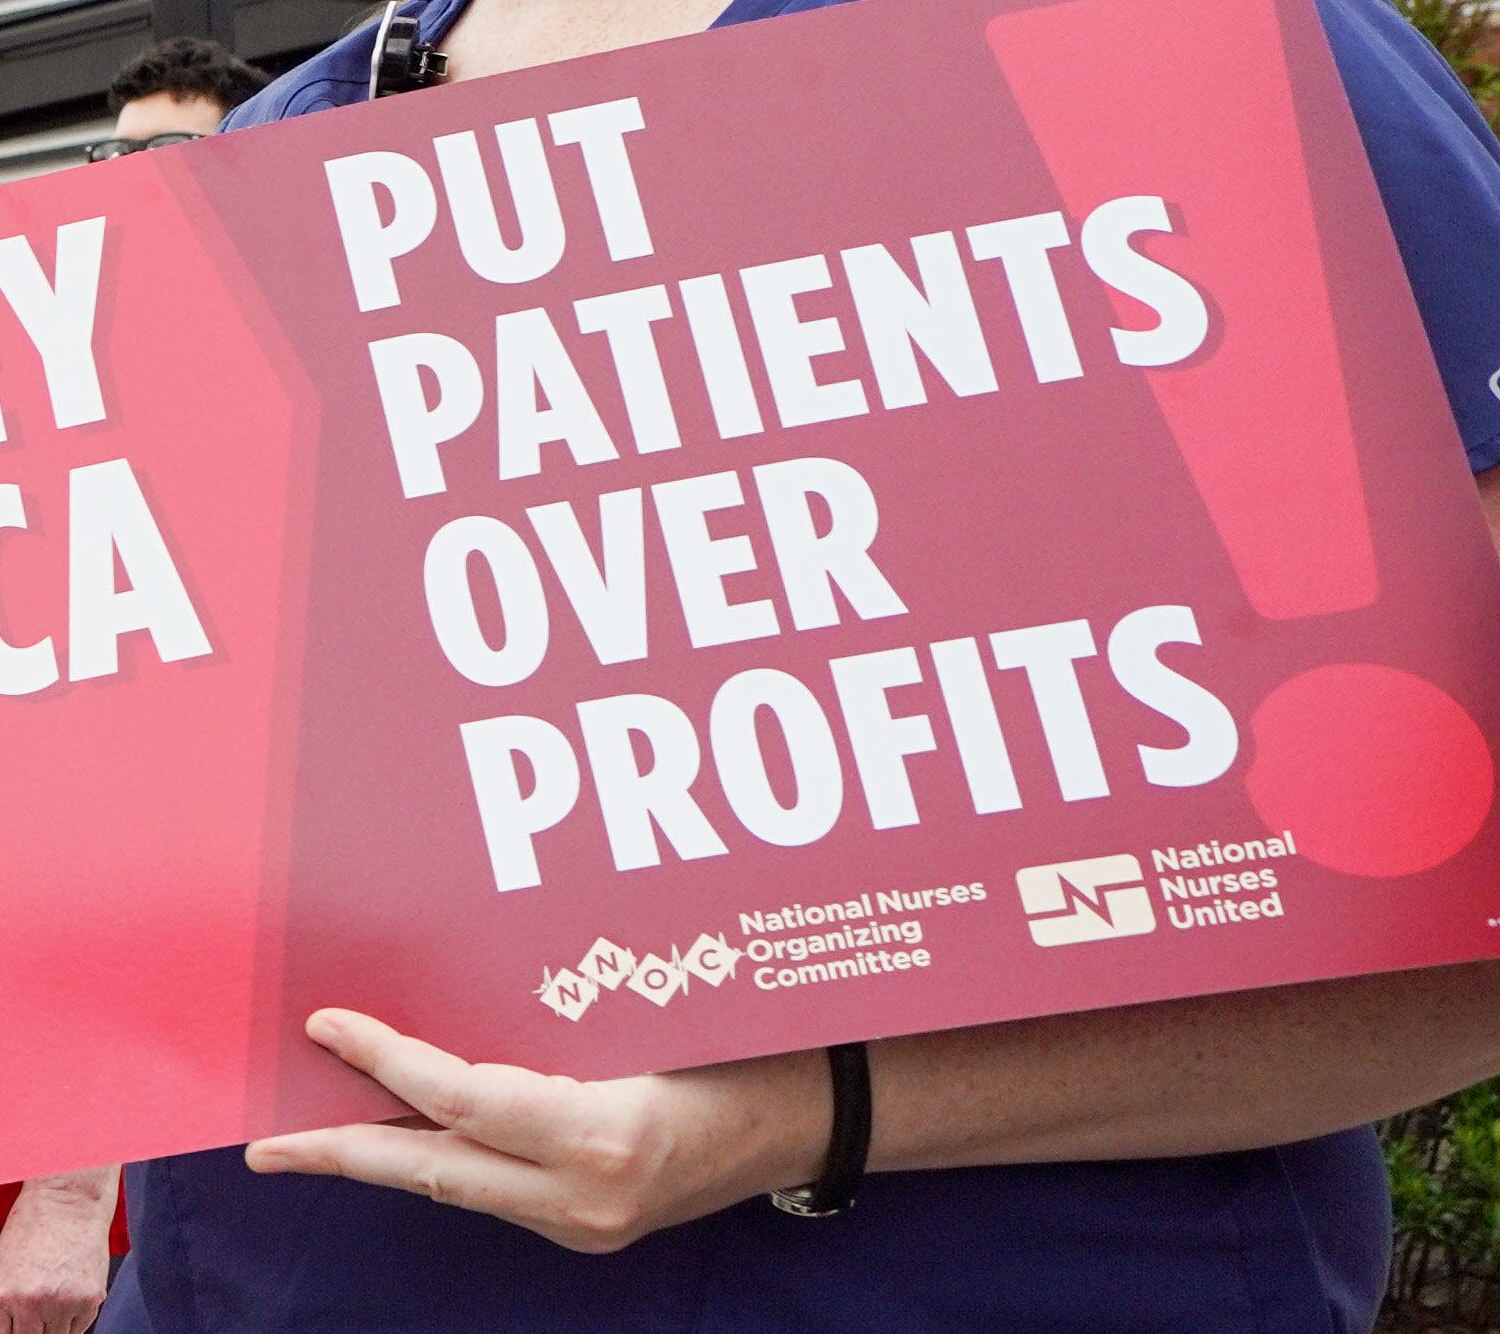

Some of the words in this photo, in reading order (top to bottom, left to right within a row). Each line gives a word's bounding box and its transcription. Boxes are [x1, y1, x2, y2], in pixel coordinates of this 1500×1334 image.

[324, 97, 654, 312] PUT
[368, 196, 1208, 499] PATIENTS
[424, 458, 909, 686] OVER
[460, 605, 1238, 892] PROFITS
[1152, 831, 1296, 872] National
[1160, 869, 1277, 901] Nurses
[739, 894, 873, 935] National
[877, 883, 987, 914] Nurses
[1168, 892, 1284, 928] United
[748, 921, 922, 962] Organizing
[754, 949, 931, 990] Committee
